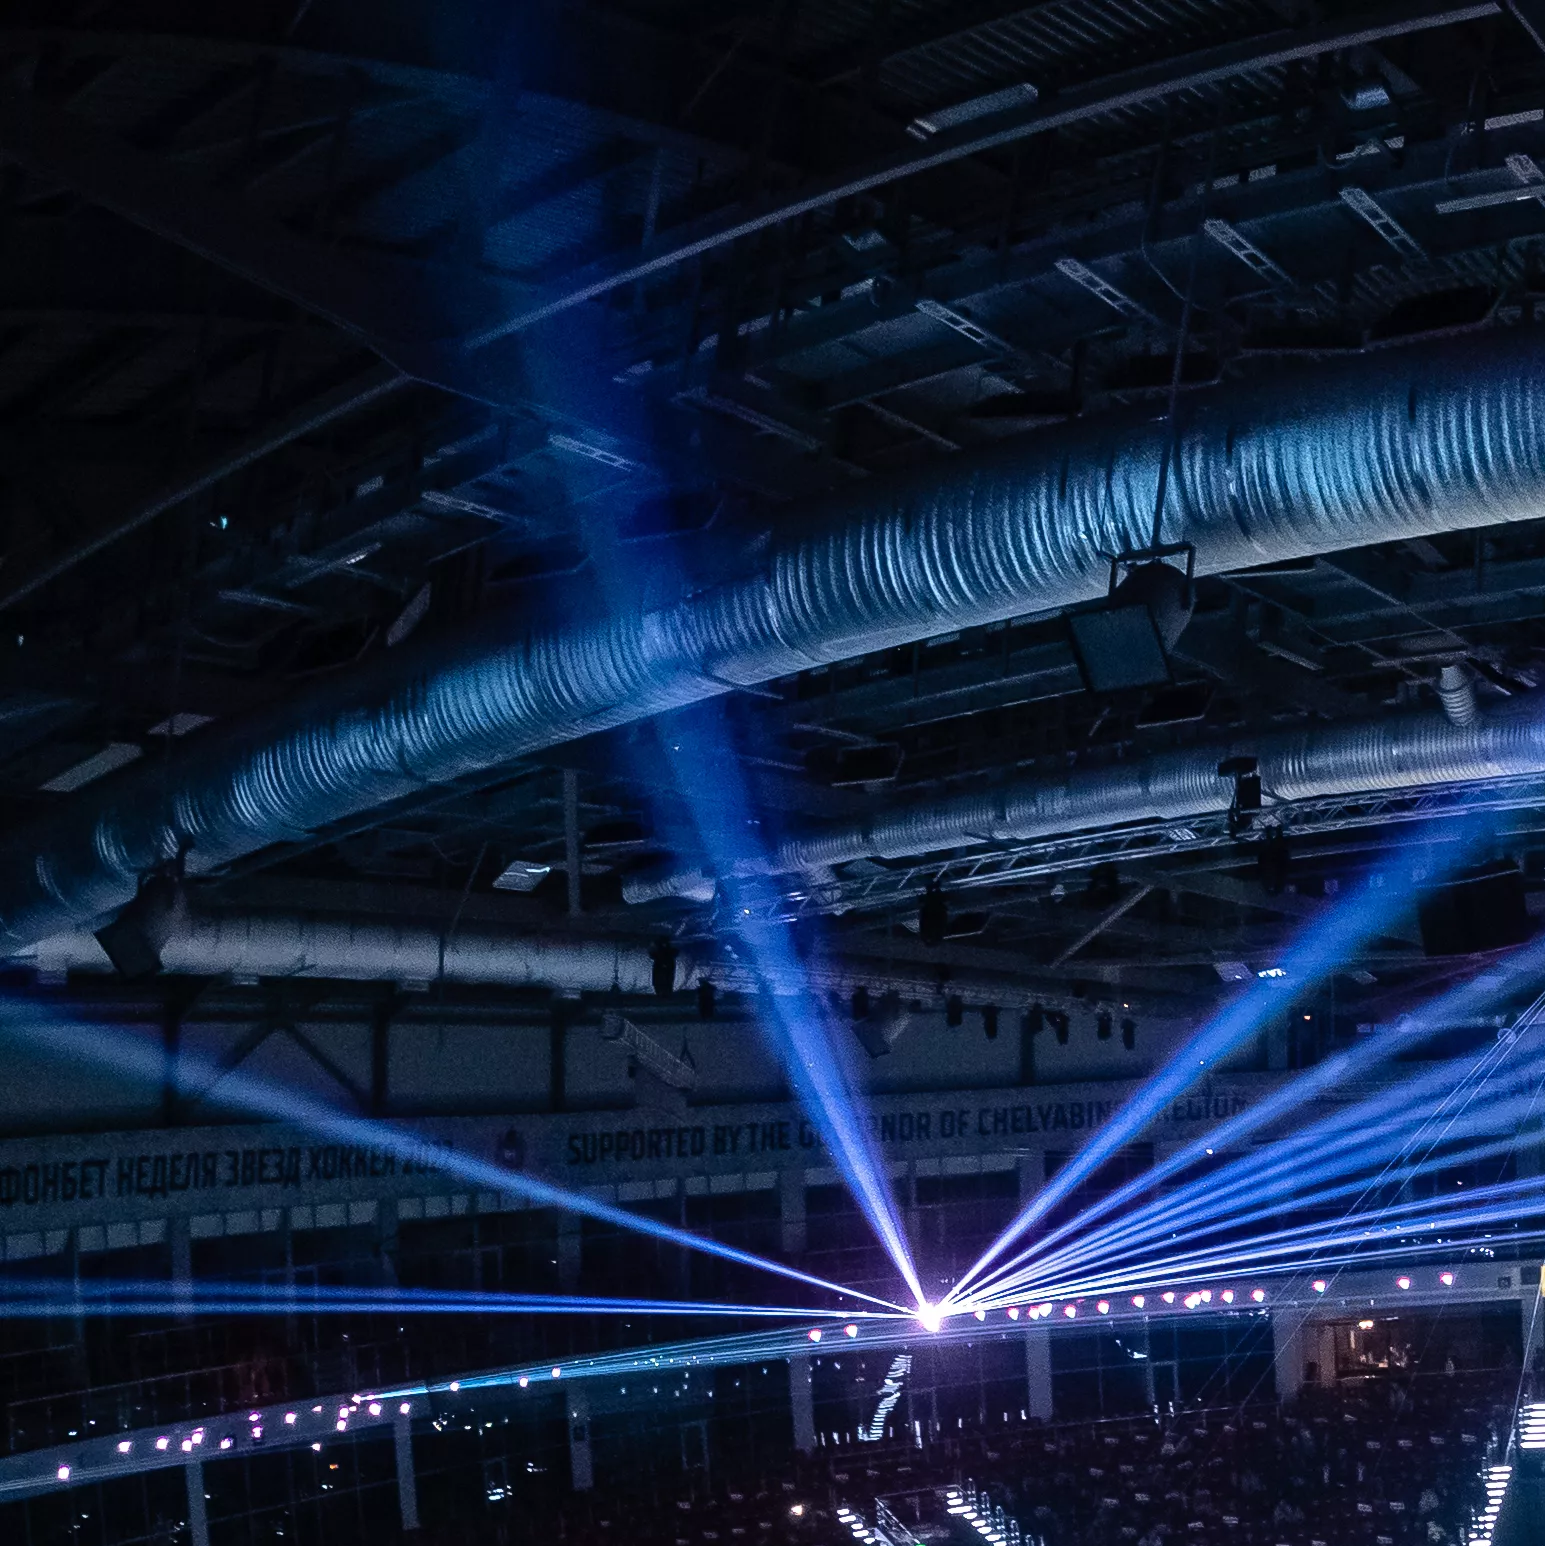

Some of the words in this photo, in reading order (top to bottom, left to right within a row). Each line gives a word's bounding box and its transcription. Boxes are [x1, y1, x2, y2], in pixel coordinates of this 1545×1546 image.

[568, 1125, 705, 1166] SUPPORTED
[712, 1125, 741, 1155] BY
[748, 1120, 792, 1152] THE
[940, 1109, 970, 1139] OF
[117, 1152, 218, 1198] НЕДЕЛЯ
[225, 1146, 302, 1188] ЗВЕЗД
